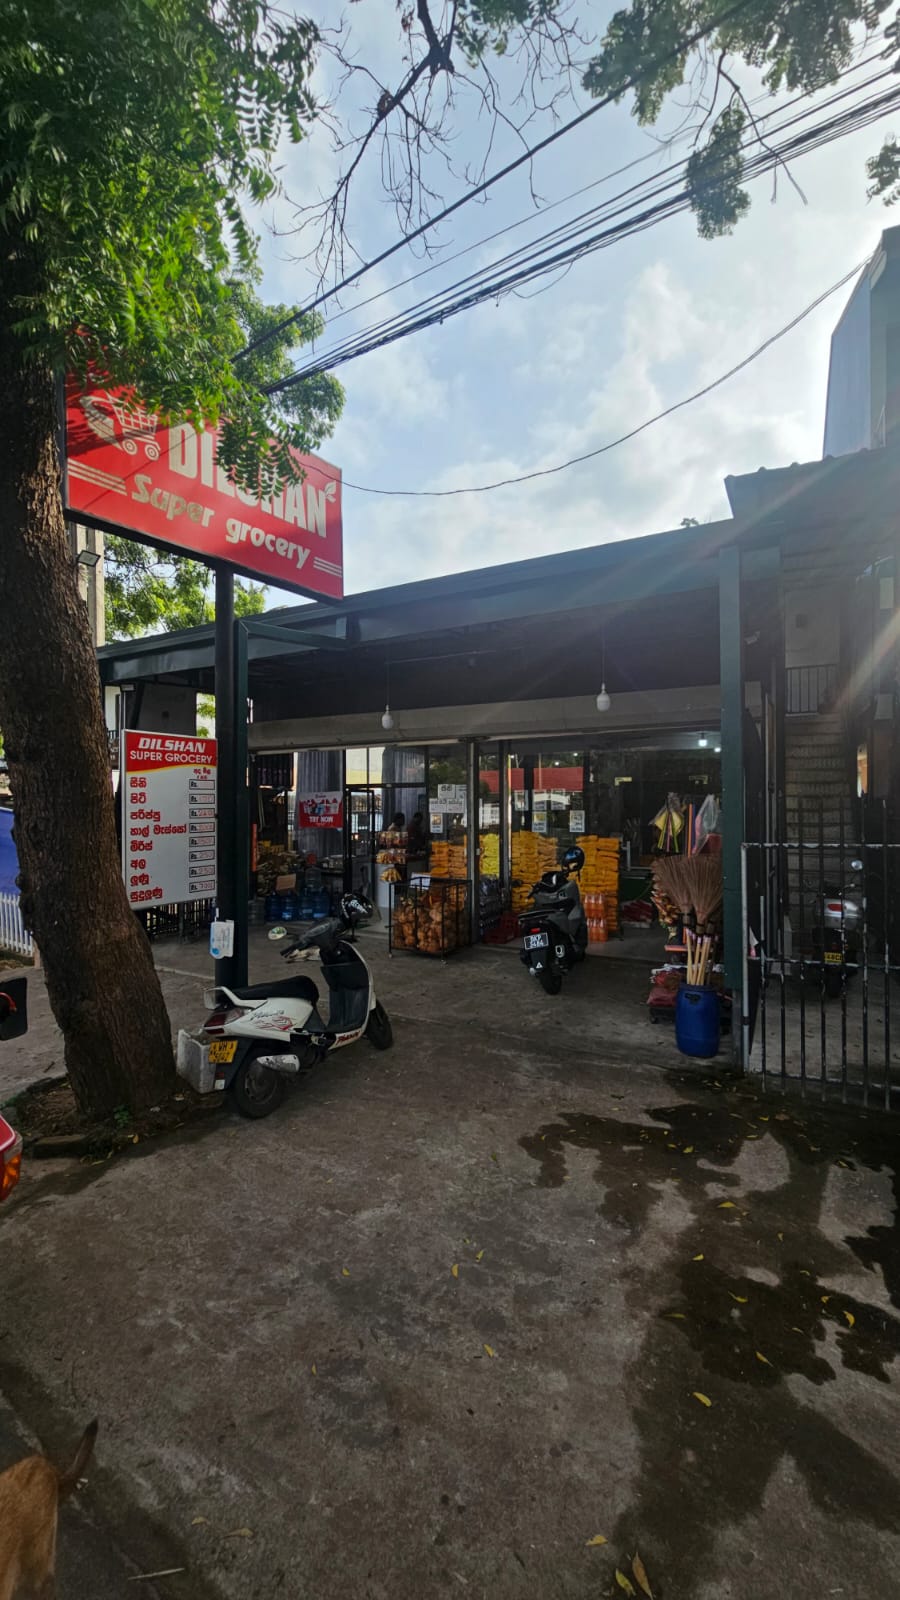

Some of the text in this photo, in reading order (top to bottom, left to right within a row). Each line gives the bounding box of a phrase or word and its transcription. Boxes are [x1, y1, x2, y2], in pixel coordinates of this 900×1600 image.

[168, 419, 327, 538] DIAN
[131, 473, 311, 569] Super grocery
[130, 750, 213, 763] SUPER GROCERY
[138, 737, 206, 753] DILSHAN
